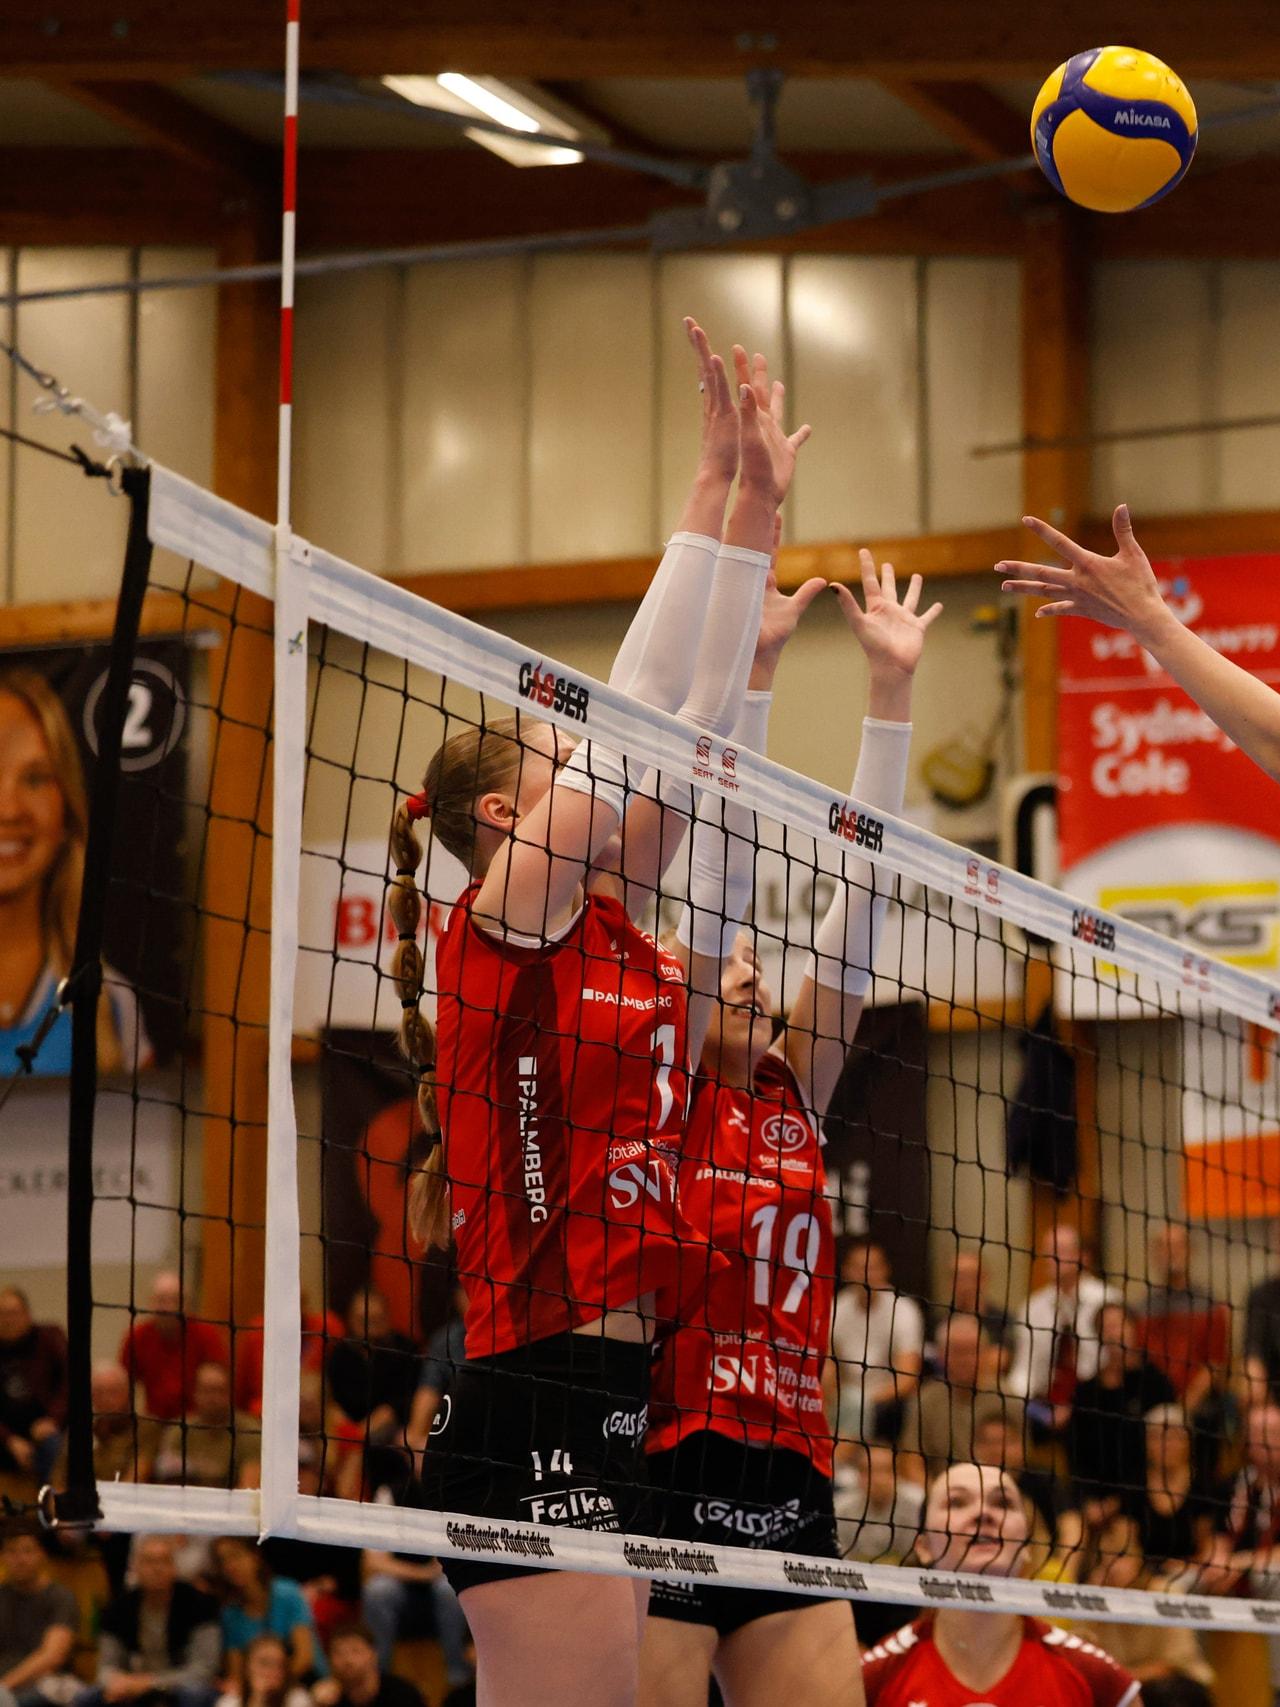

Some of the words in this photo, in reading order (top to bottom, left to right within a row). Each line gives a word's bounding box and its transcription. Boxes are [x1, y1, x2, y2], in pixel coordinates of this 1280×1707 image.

[121, 680, 153, 749] 2
[518, 660, 590, 724] GASSER
[692, 766, 715, 782] SEAT
[718, 777, 741, 793] SEAT
[1091, 750, 1190, 797] Cole
[828, 800, 884, 854] GASSER
[595, 991, 672, 1011] PALMBERG
[518, 1080, 548, 1223] PALMBERG
[751, 1204, 821, 1314] 19
[531, 1448, 574, 1482] 14
